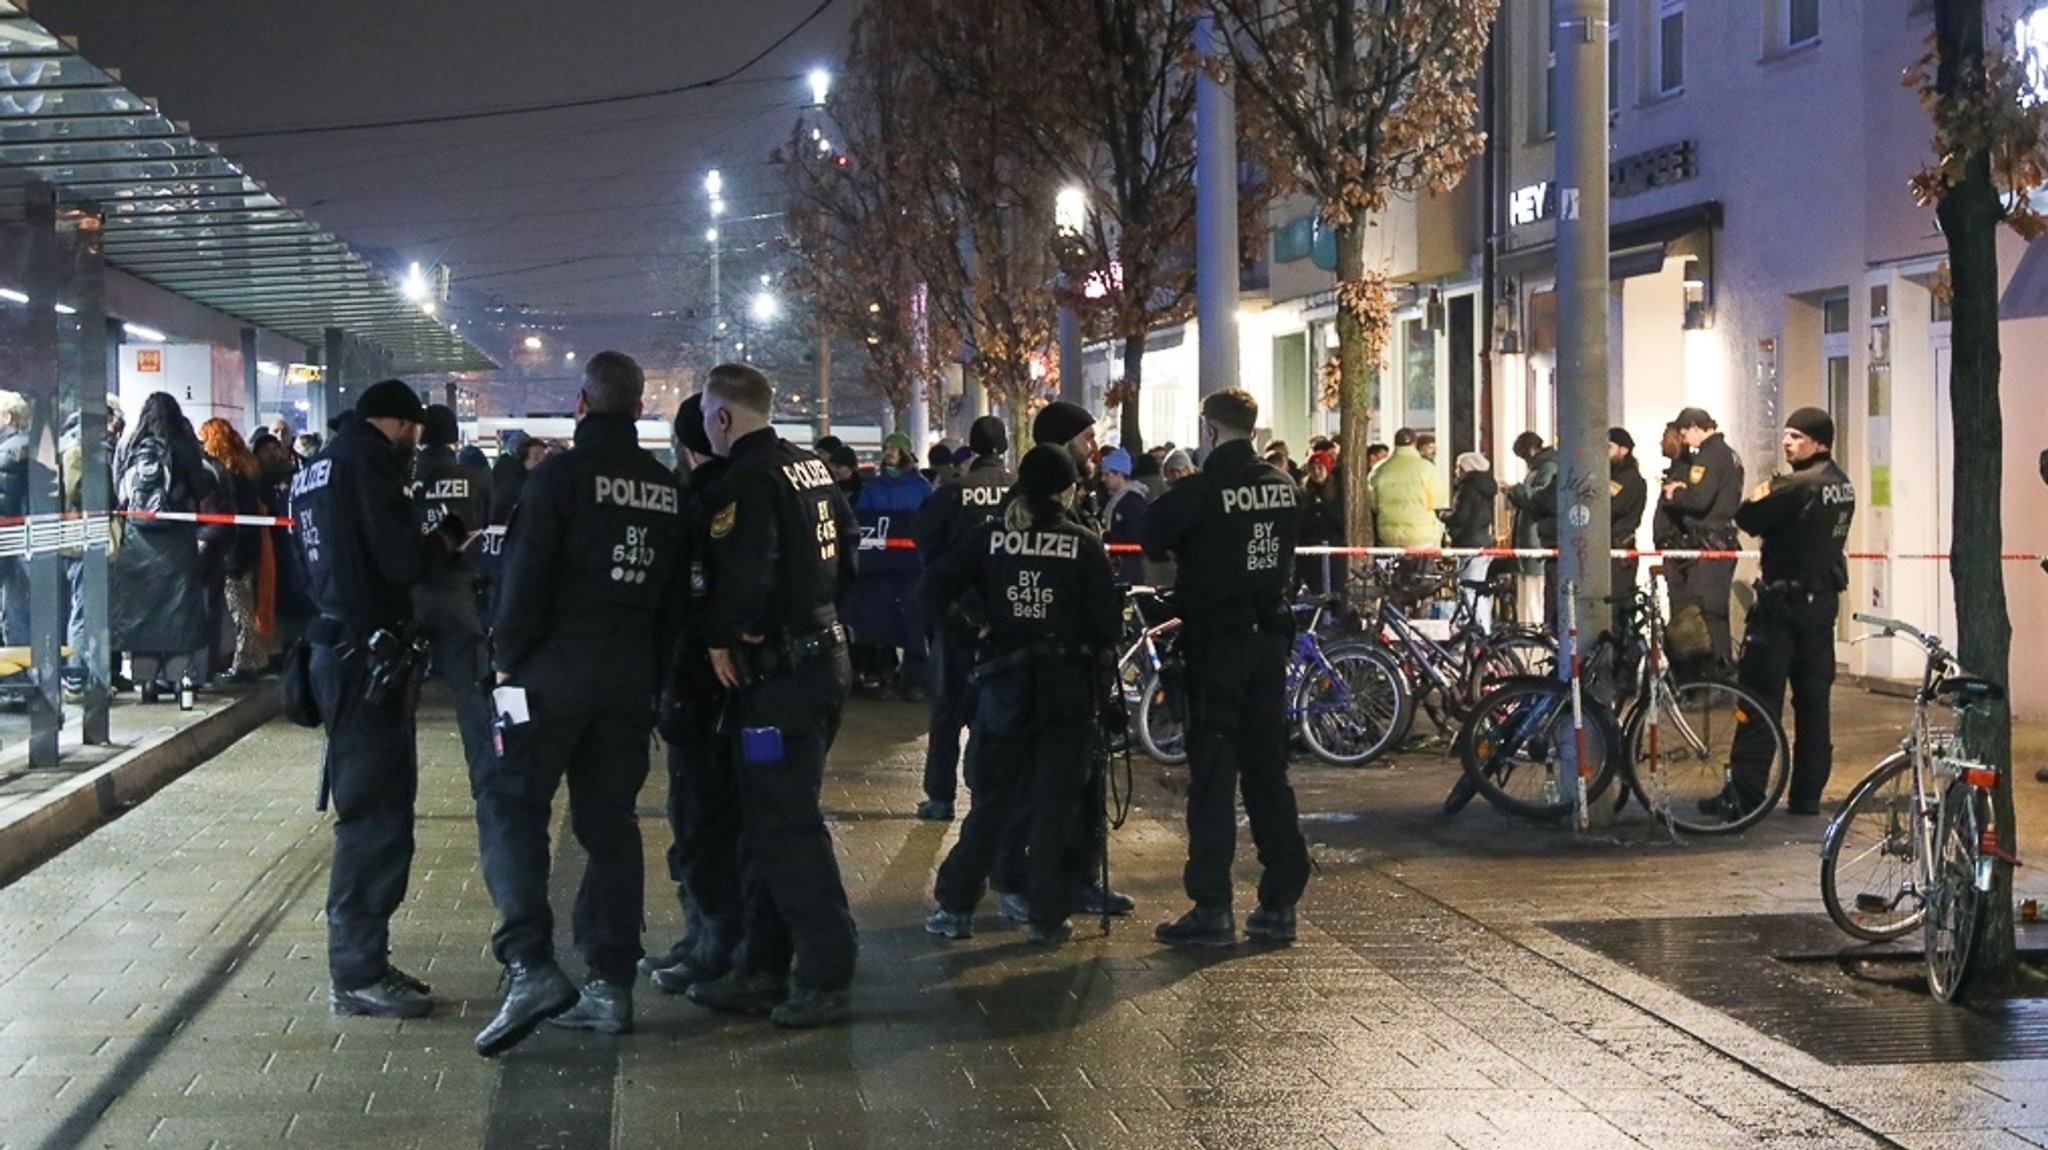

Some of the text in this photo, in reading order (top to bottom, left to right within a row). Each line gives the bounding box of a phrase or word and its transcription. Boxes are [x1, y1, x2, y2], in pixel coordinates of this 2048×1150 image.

[1509, 182, 1547, 227] HEY
[782, 459, 834, 492] POLIZEI
[595, 476, 678, 514] POLIZEI
[1221, 484, 1297, 514] POLIZEI
[626, 525, 647, 546] BY
[1253, 521, 1274, 539] BY
[989, 530, 1079, 560] POLIZEI
[1247, 536, 1279, 554] 6416
[1247, 553, 1278, 571] BeSi
[1018, 570, 1041, 586] BY
[1006, 585, 1053, 603] 6416
[1013, 602, 1046, 619] BeSi
